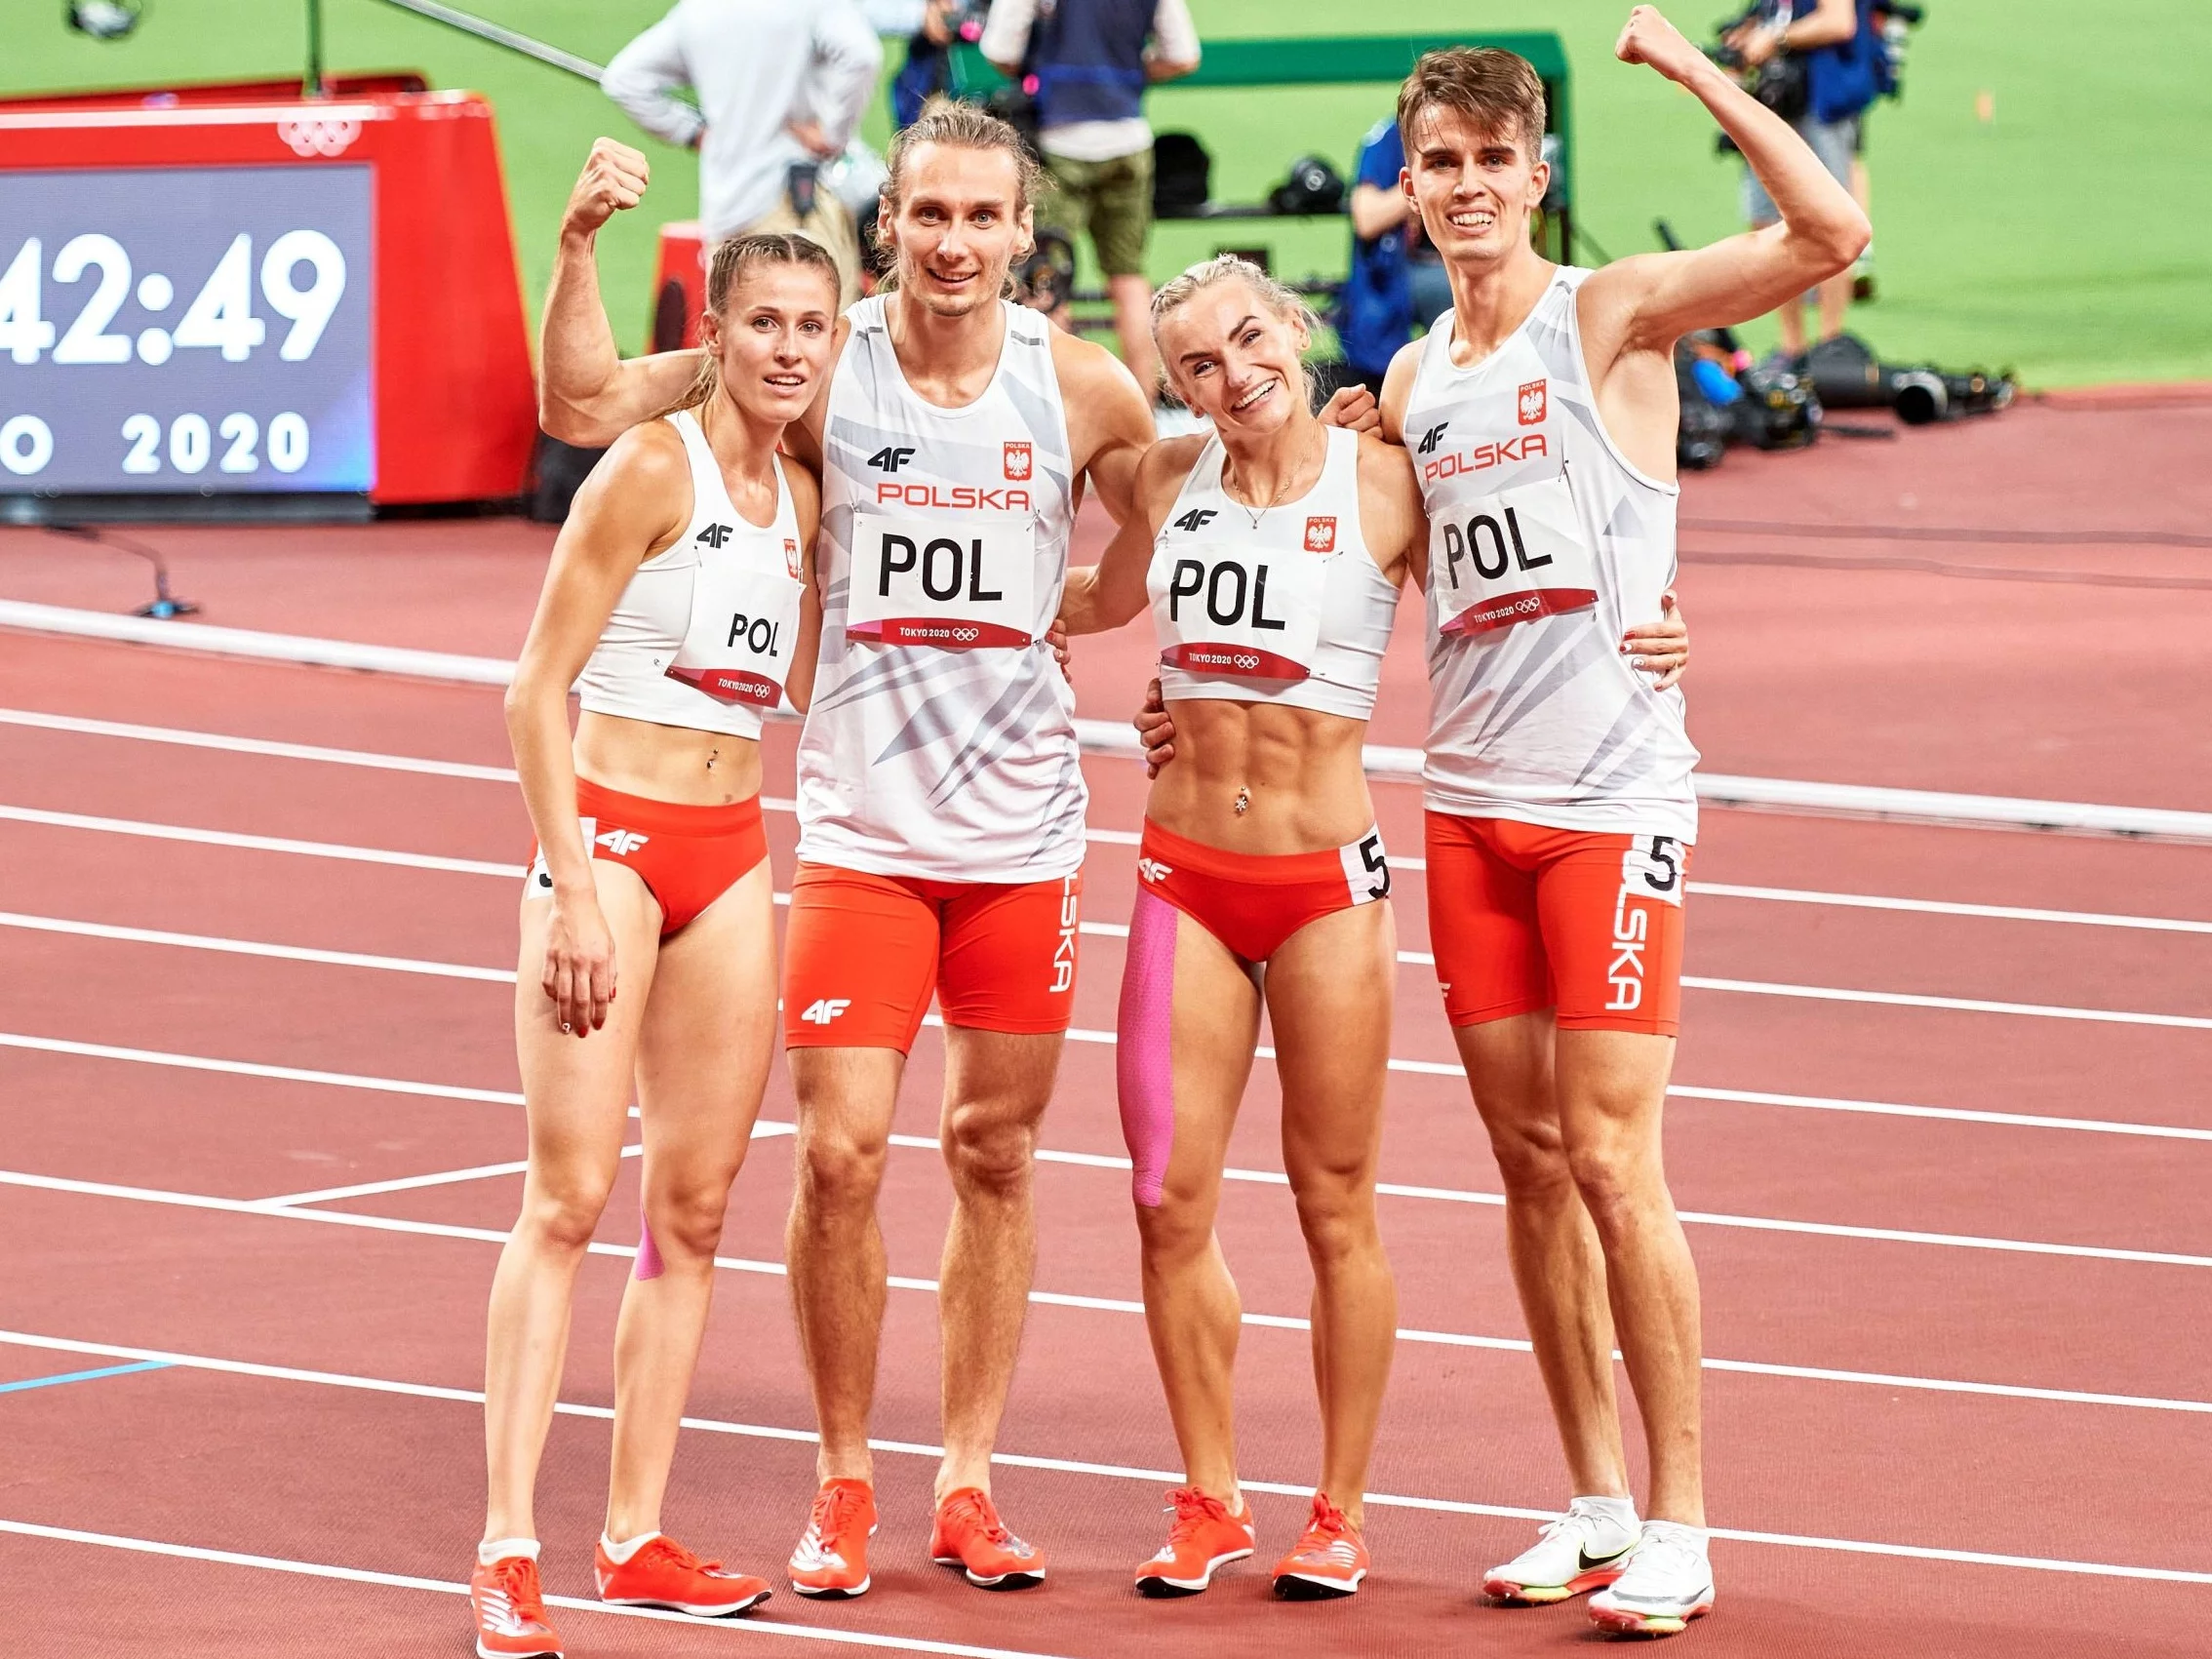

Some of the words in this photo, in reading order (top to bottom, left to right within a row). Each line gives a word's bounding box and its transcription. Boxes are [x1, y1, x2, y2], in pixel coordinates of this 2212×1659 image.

[123, 414, 309, 474] 2020
[1418, 421, 1449, 454] 4F
[868, 448, 916, 473] 4F
[1425, 434, 1548, 486] POLSKA
[878, 483, 1030, 511] POLSKA
[1174, 508, 1218, 532] 4F
[695, 523, 733, 549] 4F
[1443, 507, 1553, 590] POL
[879, 533, 1003, 602] POL
[1170, 559, 1285, 630] POL
[1474, 611, 1496, 623] TOKYO
[1496, 606, 1515, 618] 2020
[728, 612, 778, 657] POL
[899, 627, 928, 637] TOKYO
[928, 628, 950, 638] 2020
[1189, 652, 1210, 663] TOKYO
[1211, 654, 1232, 664] 2020
[595, 829, 650, 856] 4F
[1360, 833, 1391, 899] 5
[1644, 836, 1677, 891] 5
[802, 999, 851, 1025] 4F
